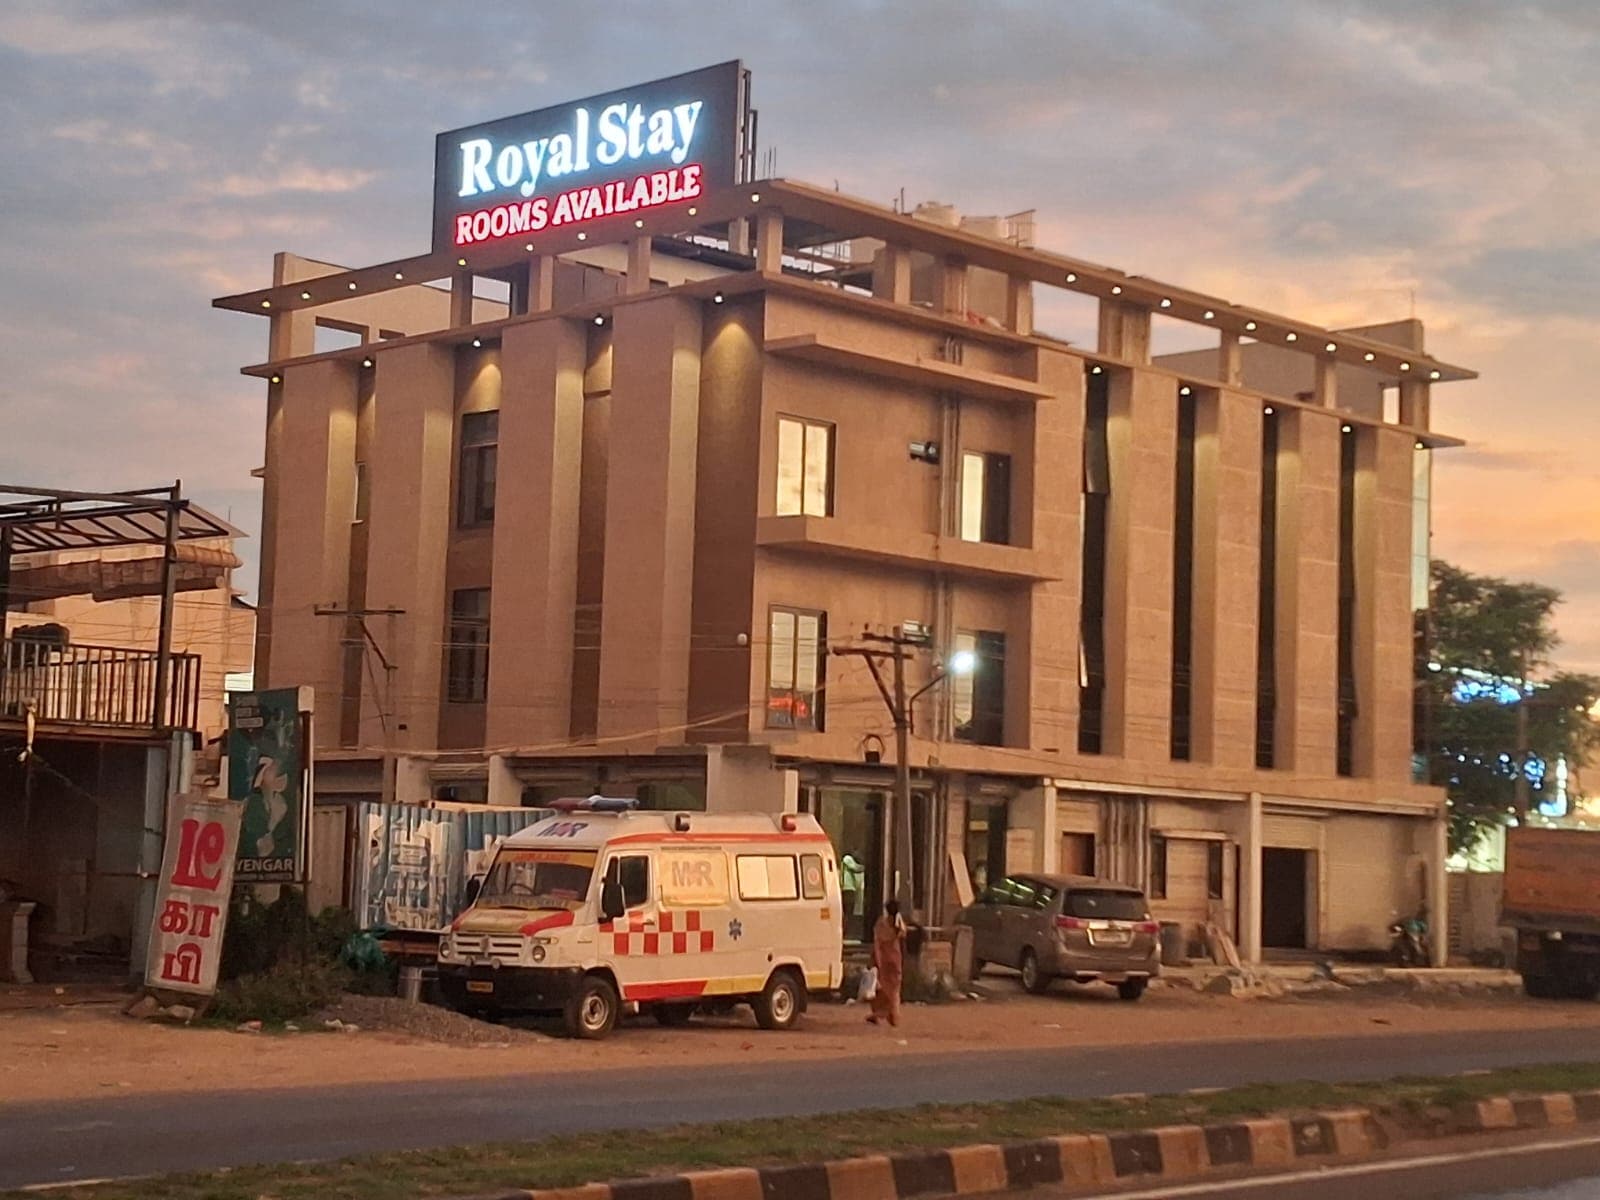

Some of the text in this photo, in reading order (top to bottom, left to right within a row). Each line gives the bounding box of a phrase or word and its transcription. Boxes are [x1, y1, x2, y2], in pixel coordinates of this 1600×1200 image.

[458, 101, 702, 197] Royal Stay
[456, 164, 701, 245] ROOMS AVAILABLE
